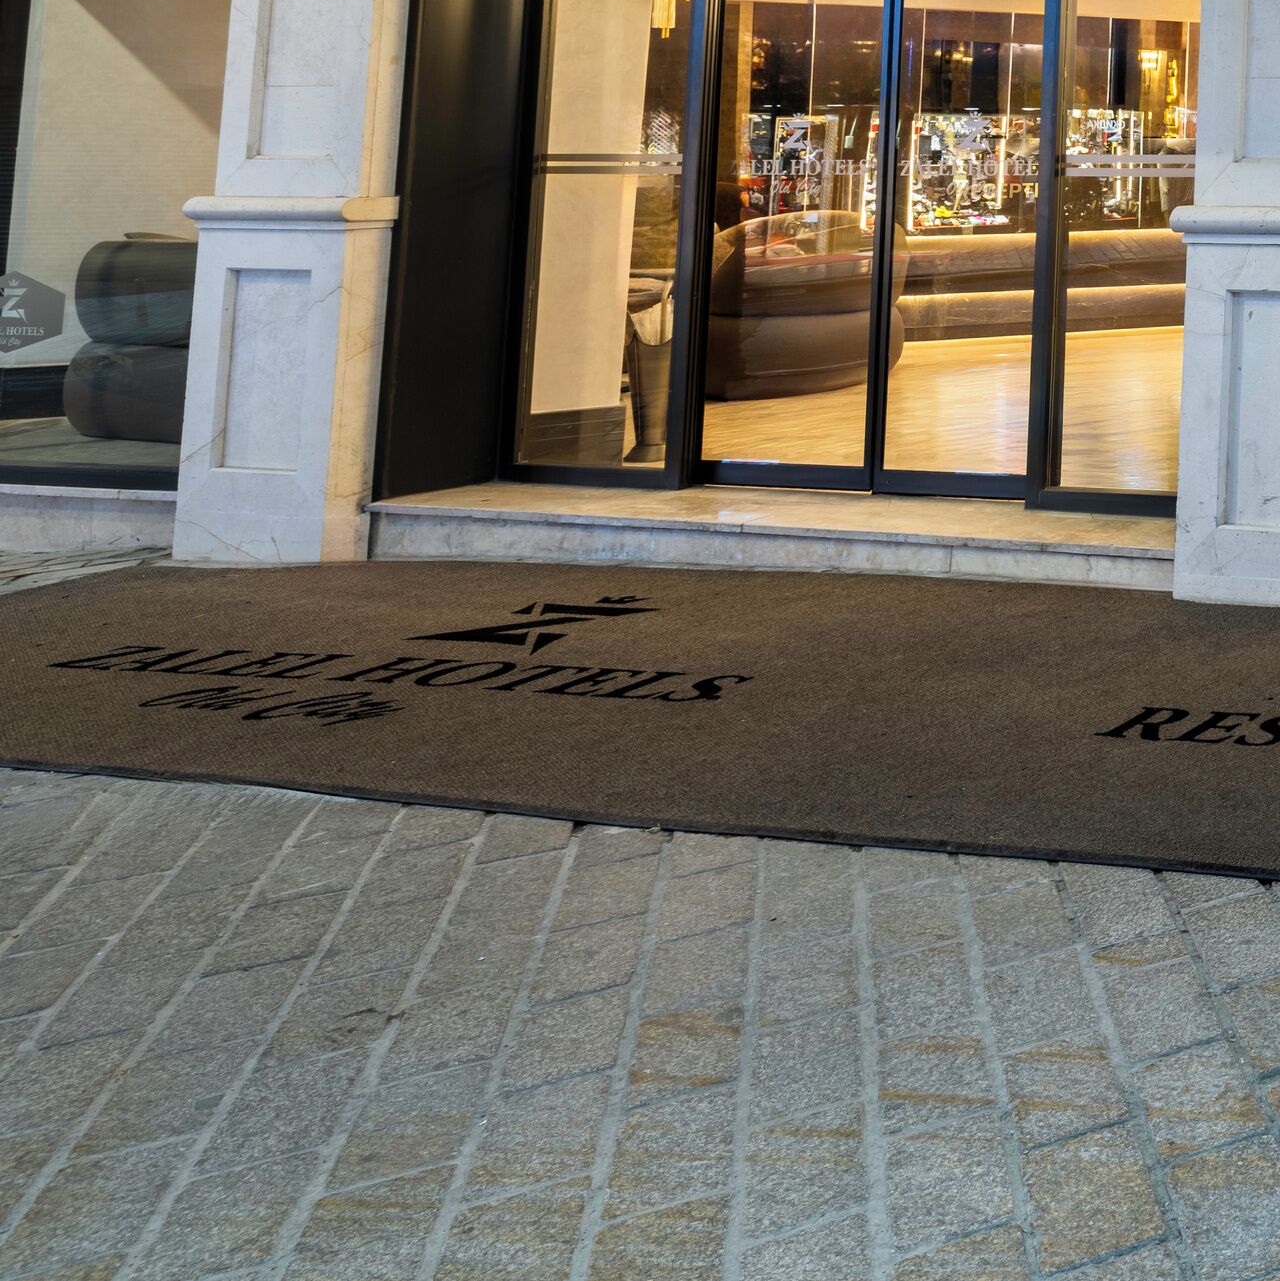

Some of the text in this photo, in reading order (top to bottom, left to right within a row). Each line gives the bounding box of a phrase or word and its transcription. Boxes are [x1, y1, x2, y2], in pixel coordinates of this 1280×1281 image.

[789, 158, 871, 176] HOTELS
[6, 326, 45, 336] HOTELS
[47, 645, 755, 703] ZALEL HOTELS
[138, 684, 406, 727] Old City
